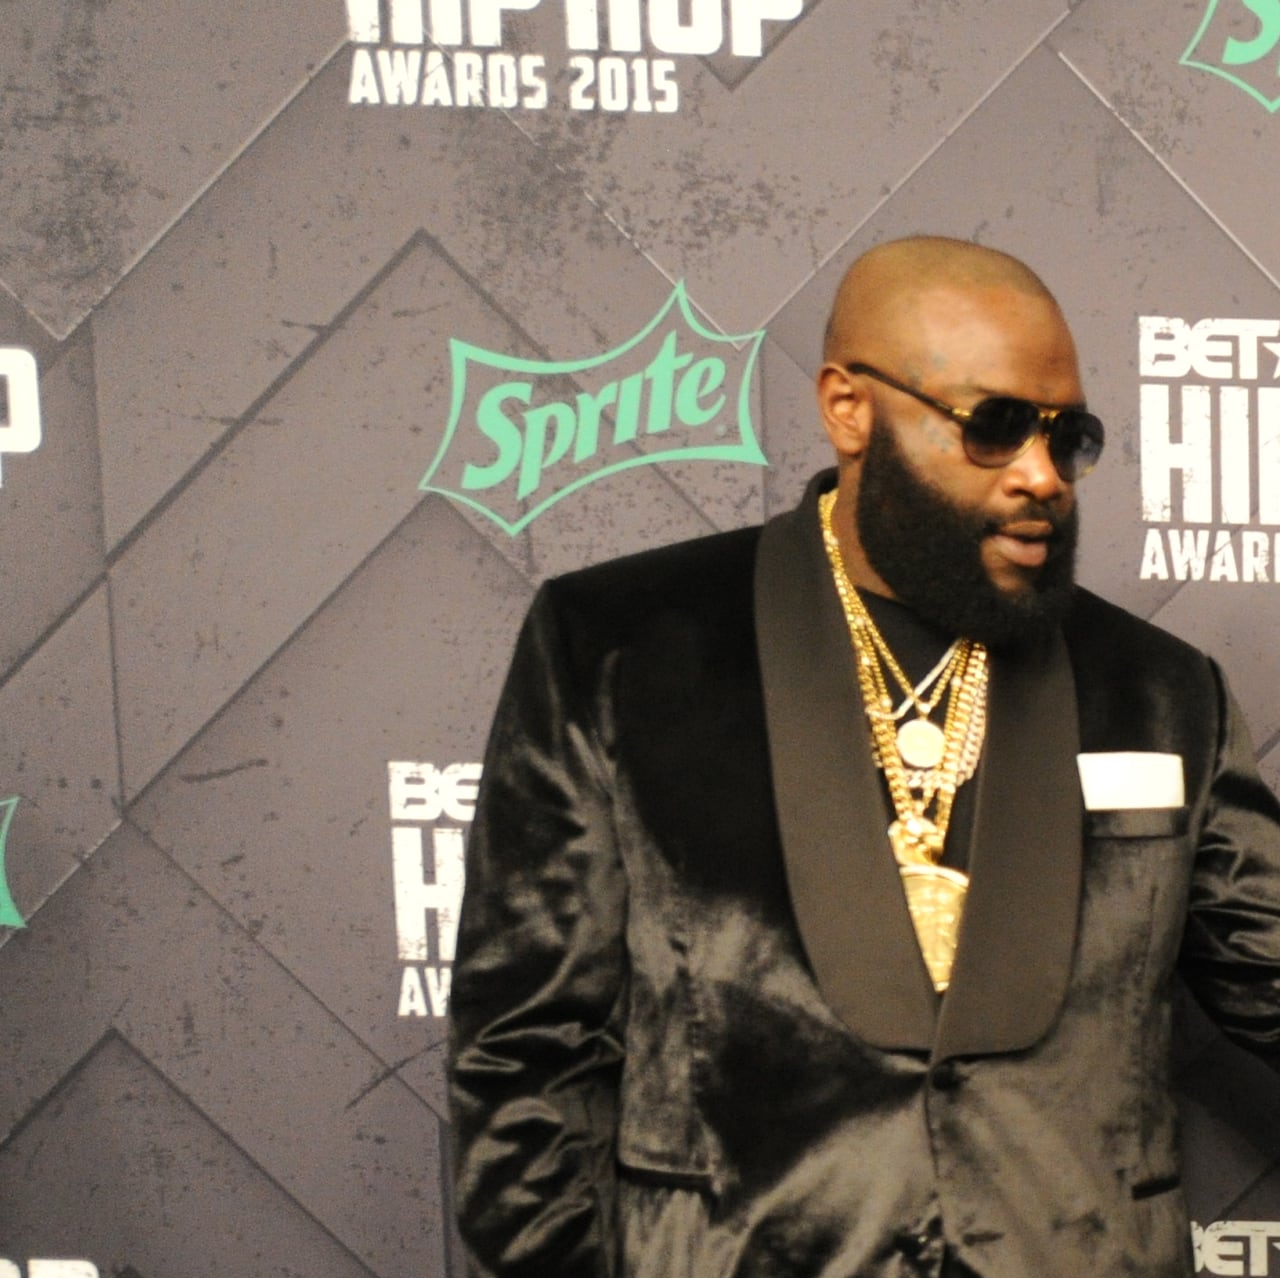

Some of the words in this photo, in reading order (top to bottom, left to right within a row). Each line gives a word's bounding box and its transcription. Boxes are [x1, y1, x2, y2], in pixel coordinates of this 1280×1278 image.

[348, 48, 548, 110] AWARDS
[568, 54, 679, 114] 2015
[460, 330, 727, 500] Sprite
[387, 760, 485, 822] BE
